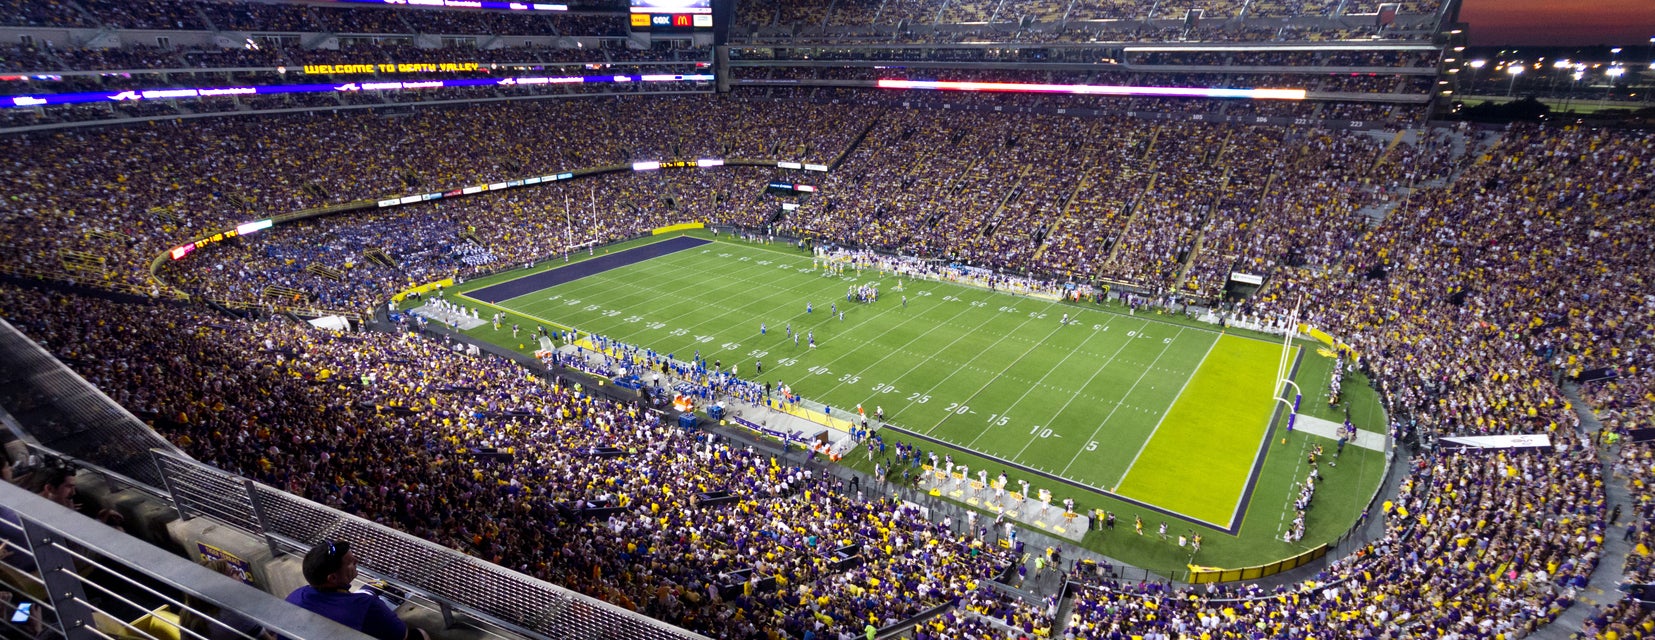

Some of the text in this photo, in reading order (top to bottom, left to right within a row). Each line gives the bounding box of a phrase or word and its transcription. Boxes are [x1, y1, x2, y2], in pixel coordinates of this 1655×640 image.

[304, 62, 479, 74] WELCOME TO DEATH VALLEY
[747, 350, 769, 358] 50
[777, 357, 798, 366] 45
[808, 366, 829, 375] 40
[838, 373, 861, 384] 35
[872, 383, 895, 393] 30
[906, 392, 932, 403] 25
[944, 403, 969, 415] 20
[987, 414, 1010, 426] 15
[1030, 425, 1053, 438] 10
[1086, 440, 1099, 451] 5
